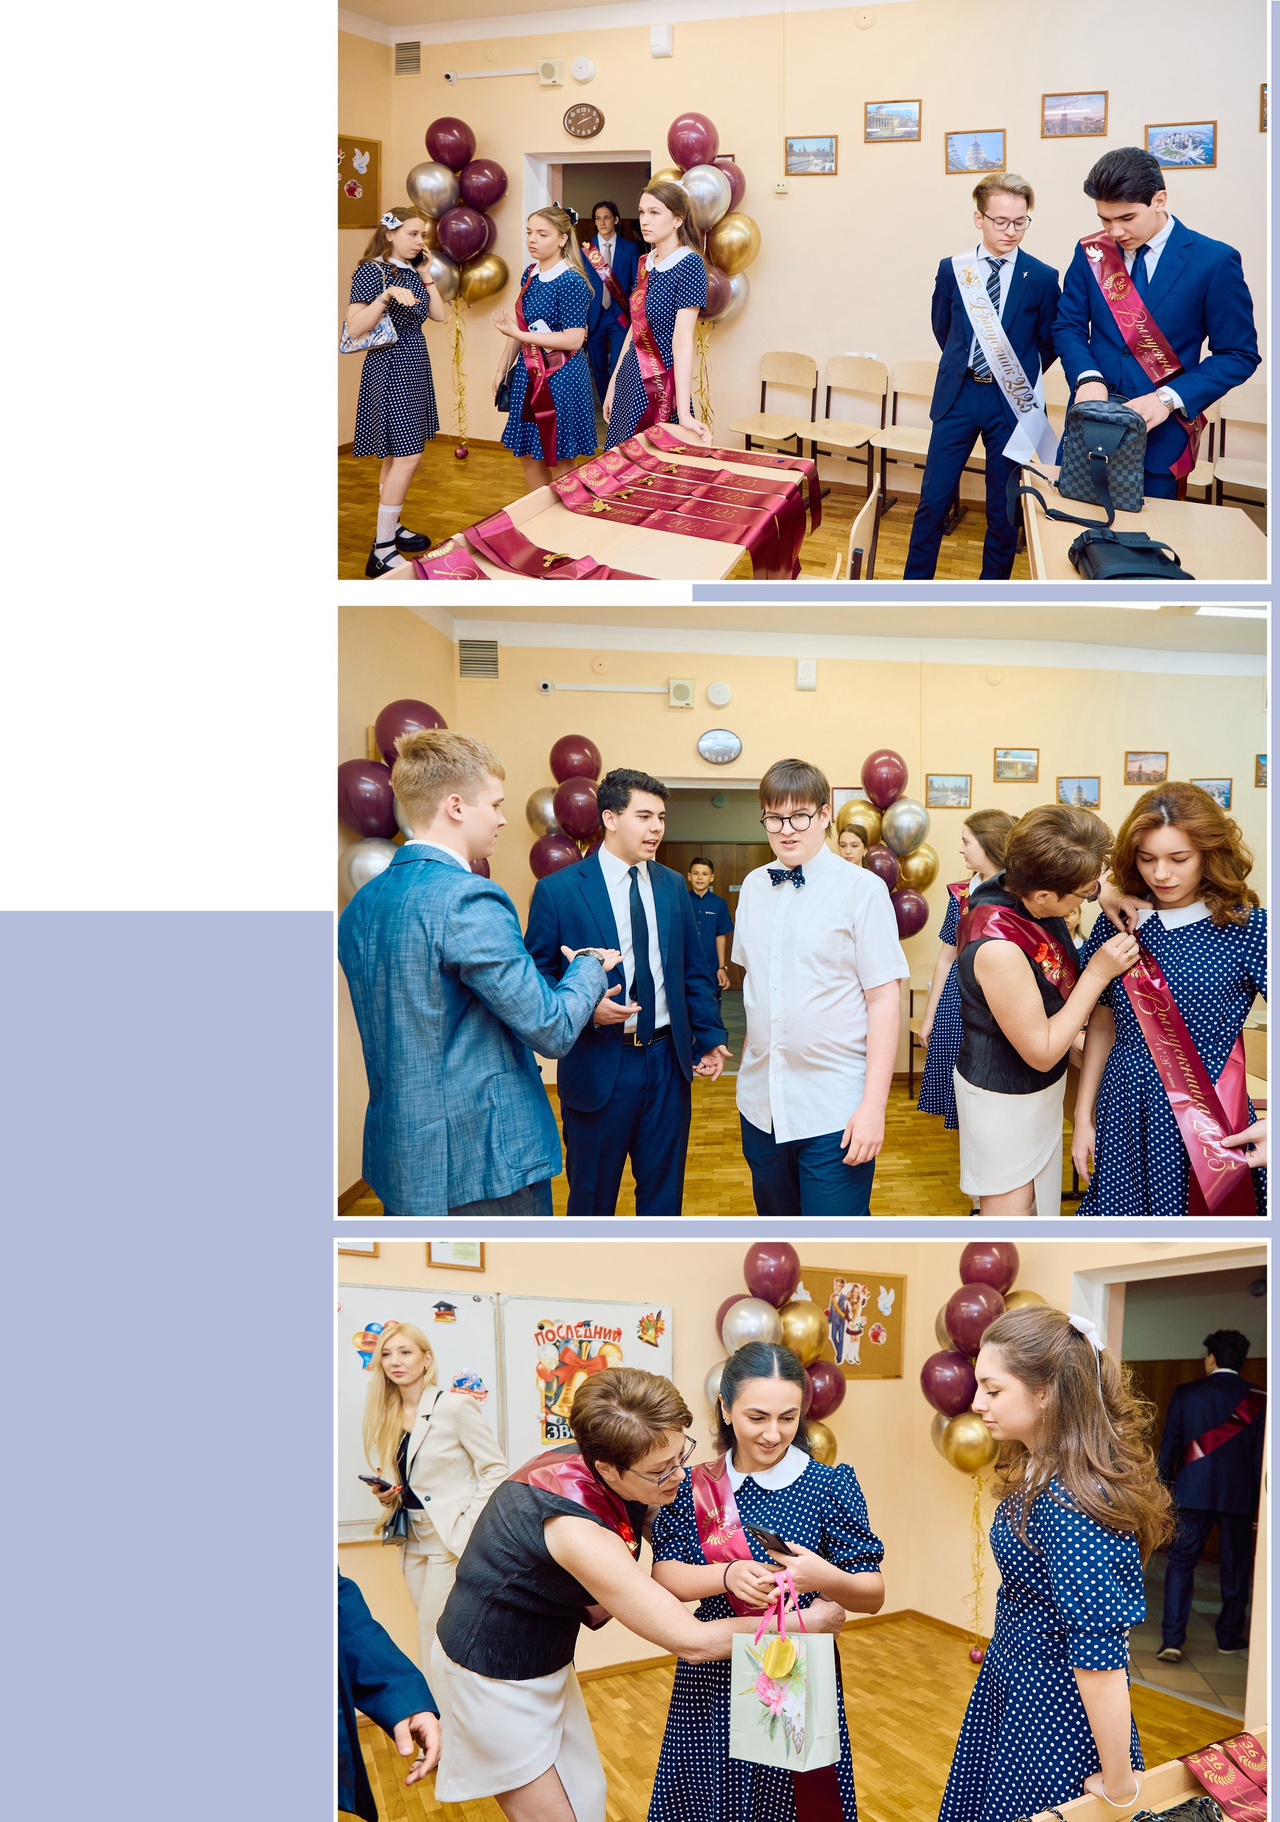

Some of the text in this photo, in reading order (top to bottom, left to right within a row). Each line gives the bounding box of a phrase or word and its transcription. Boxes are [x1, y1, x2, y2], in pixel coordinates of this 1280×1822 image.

[1116, 299, 1174, 374] Выпускни
[968, 292, 1040, 414] Выпускник 2025
[740, 454, 773, 465] 2025
[720, 475, 758, 488] 2025
[709, 489, 749, 502] 2025
[697, 505, 738, 519] 2025
[666, 516, 710, 533] 2025
[1133, 979, 1238, 1173] Выпускница 2025
[533, 1323, 623, 1347] ПОСЛЕДНИЙ
[1242, 1740, 1260, 1758] 36
[1205, 1753, 1226, 1770] 36
